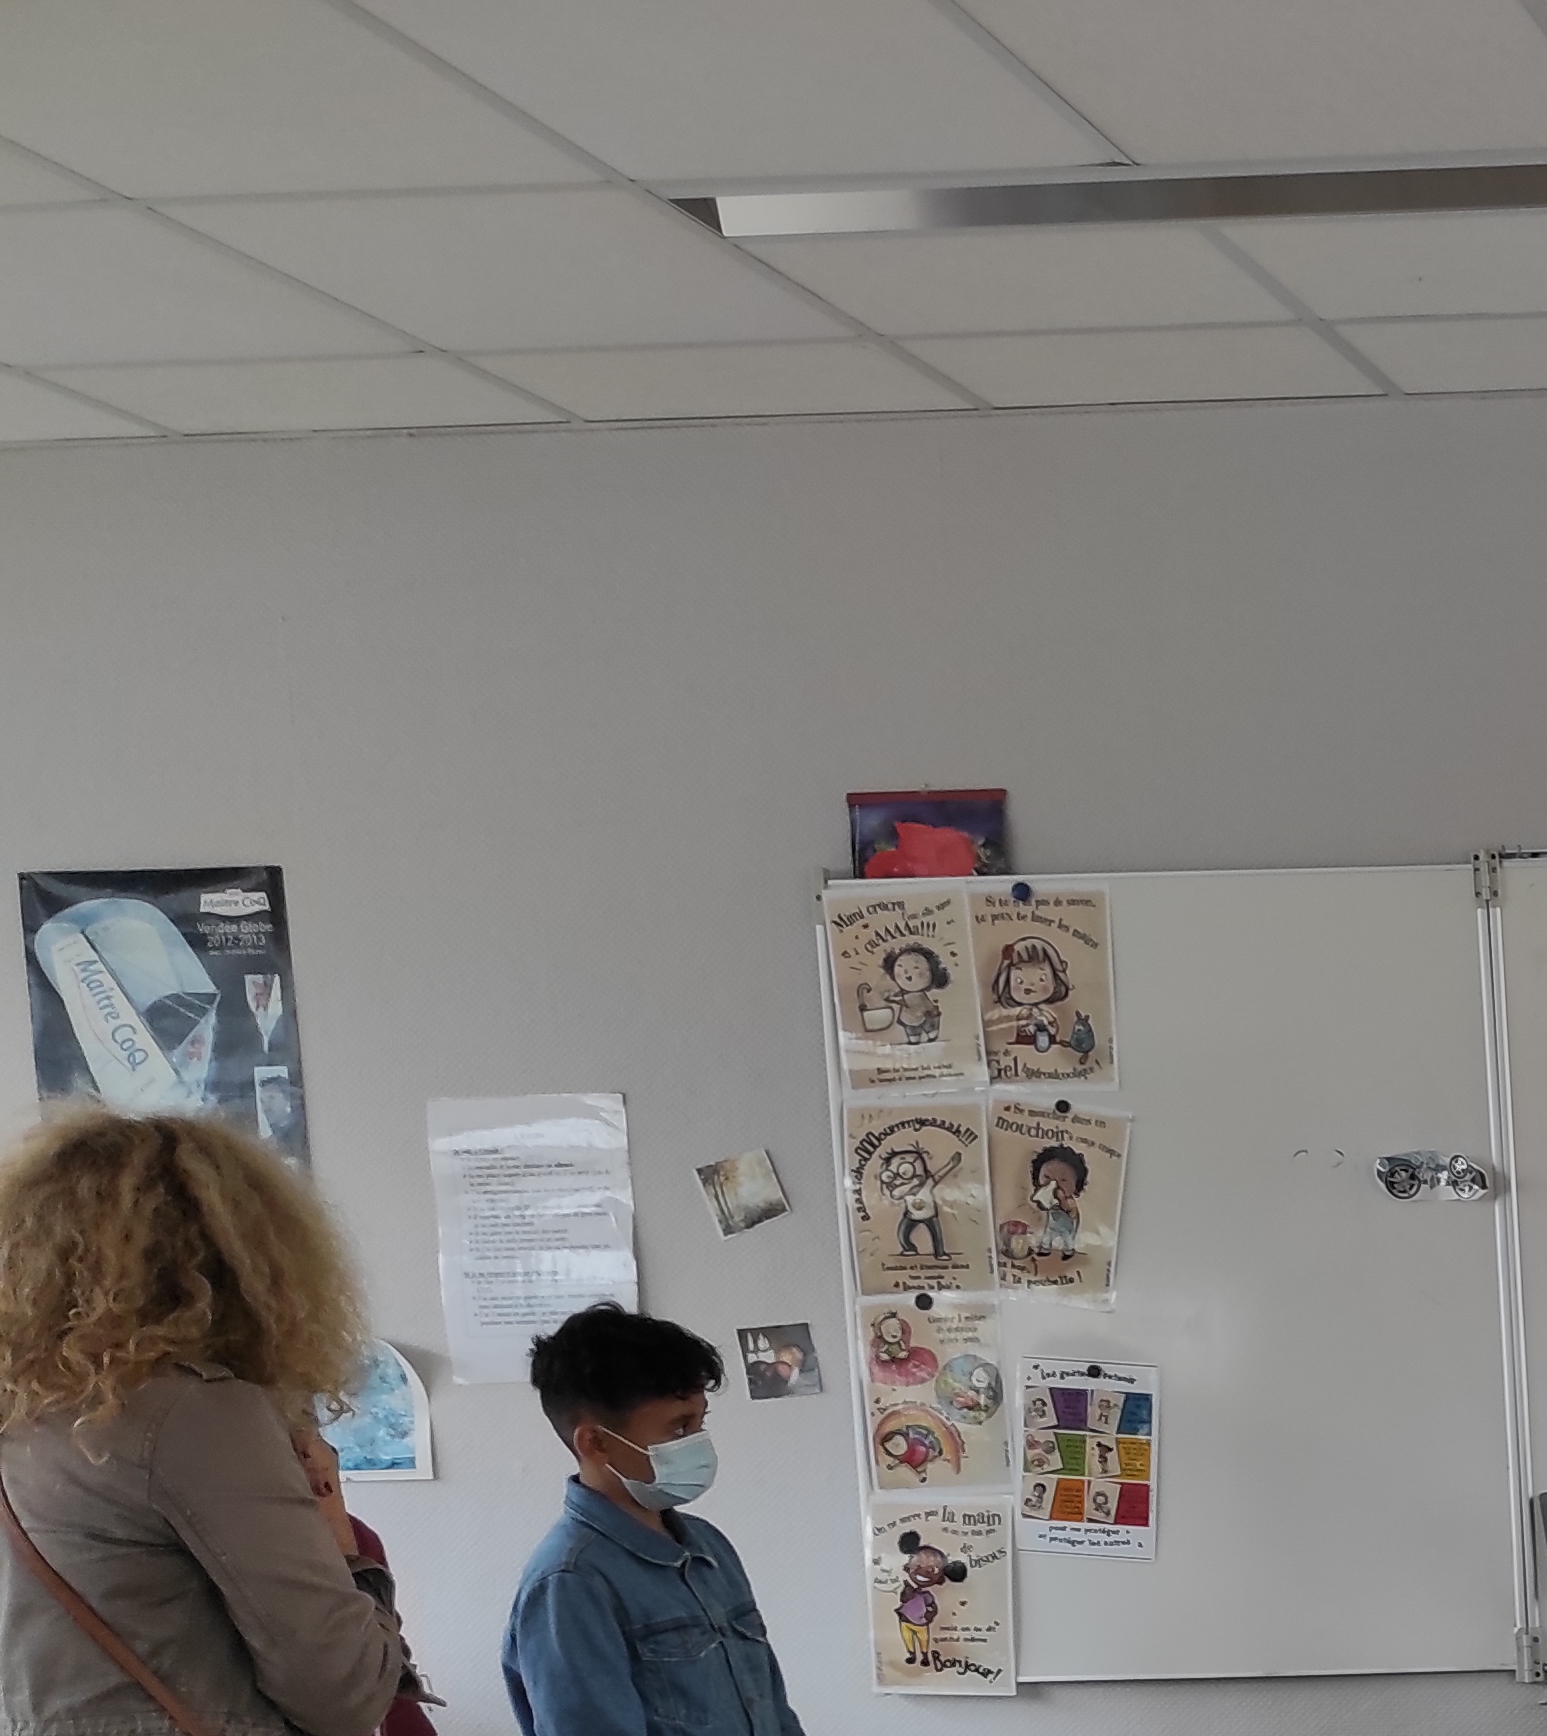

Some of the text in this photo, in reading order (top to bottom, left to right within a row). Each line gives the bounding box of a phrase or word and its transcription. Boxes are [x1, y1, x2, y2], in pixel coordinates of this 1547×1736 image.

[111, 1023, 149, 1072] CoQ
[994, 1115, 1067, 1143] mouchoir
[941, 1504, 957, 1524] la
[961, 1509, 1003, 1527] main
